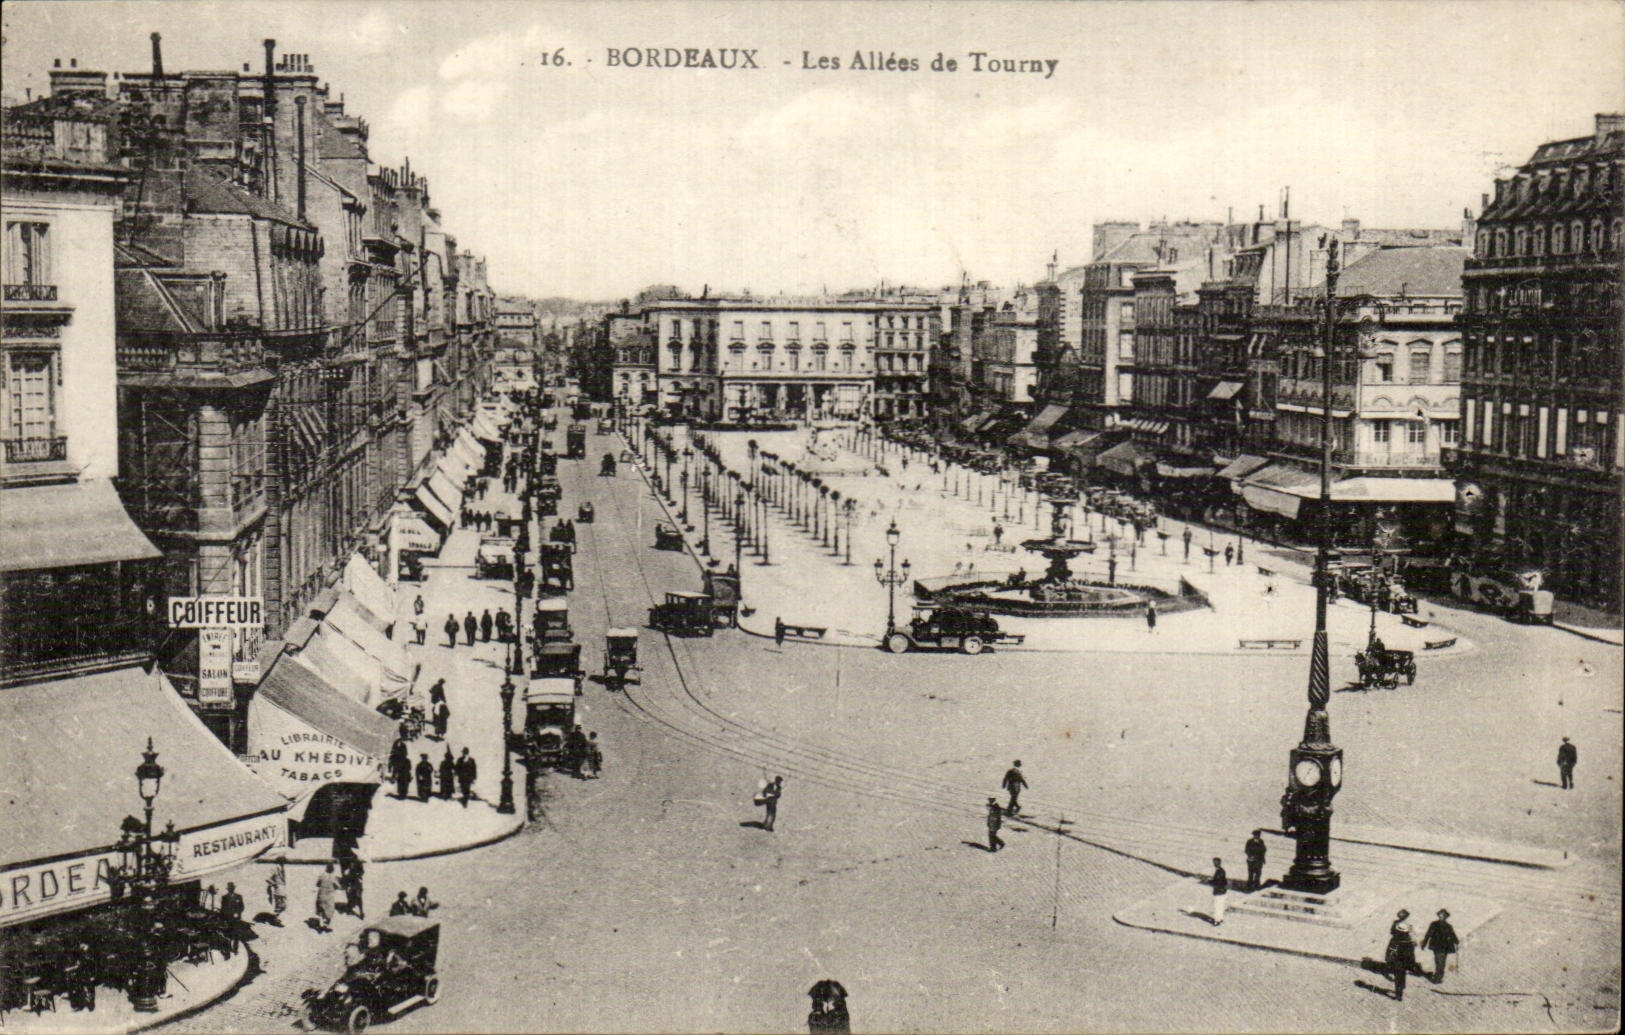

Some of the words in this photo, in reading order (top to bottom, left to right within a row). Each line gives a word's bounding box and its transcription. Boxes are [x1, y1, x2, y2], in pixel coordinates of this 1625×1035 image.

[172, 601, 261, 624] COIFFEUR
[202, 669, 228, 679] SALON
[260, 749, 281, 761] AU
[281, 767, 343, 781] TABACS
[193, 825, 278, 858] RESTAURANT
